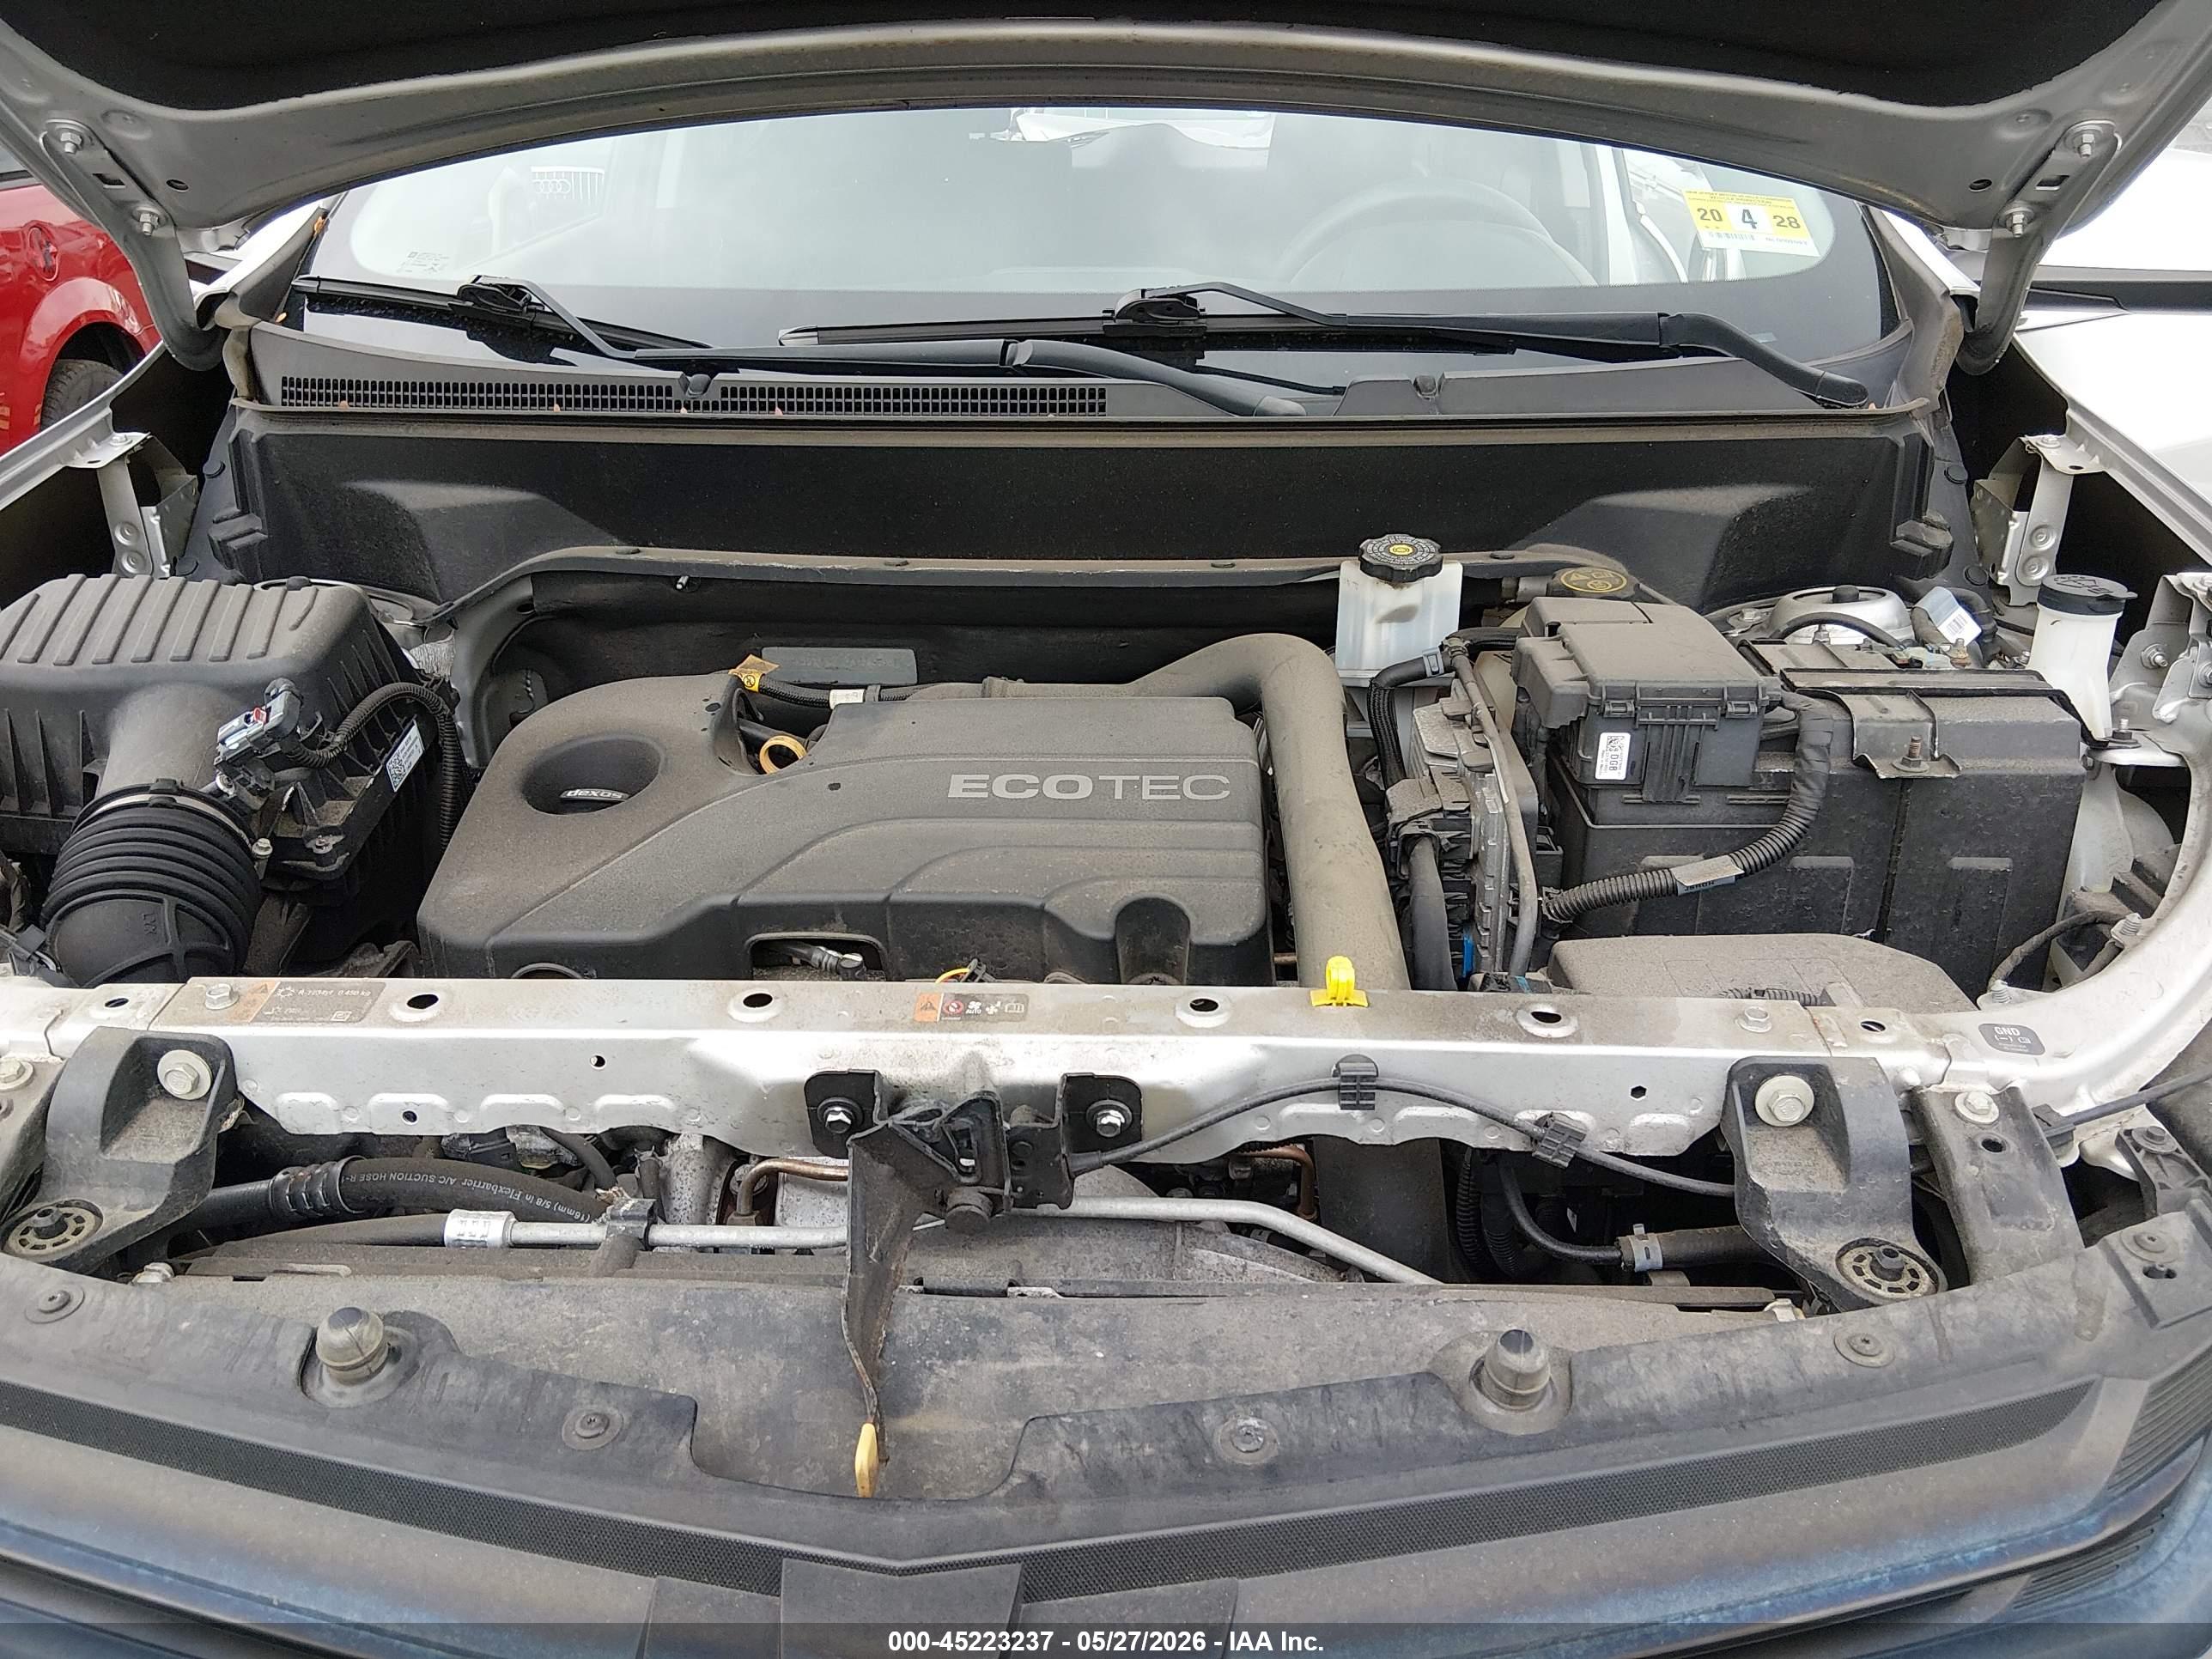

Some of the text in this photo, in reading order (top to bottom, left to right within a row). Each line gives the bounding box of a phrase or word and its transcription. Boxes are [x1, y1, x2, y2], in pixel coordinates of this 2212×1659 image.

[1697, 208, 1801, 229] 20 4 28
[1608, 754, 1619, 771] DGB
[947, 774, 1231, 800] ECOTEC
[566, 788, 623, 799] dexos
[1994, 1026, 2021, 1036] GND
[359, 1171, 386, 1182] HOSE
[389, 1171, 436, 1183] SUCTION
[438, 1176, 457, 1185] A/C
[461, 1178, 523, 1200] Flexbarrier
[536, 1197, 552, 1209] 5/8
[553, 1201, 591, 1223] (16mm)
